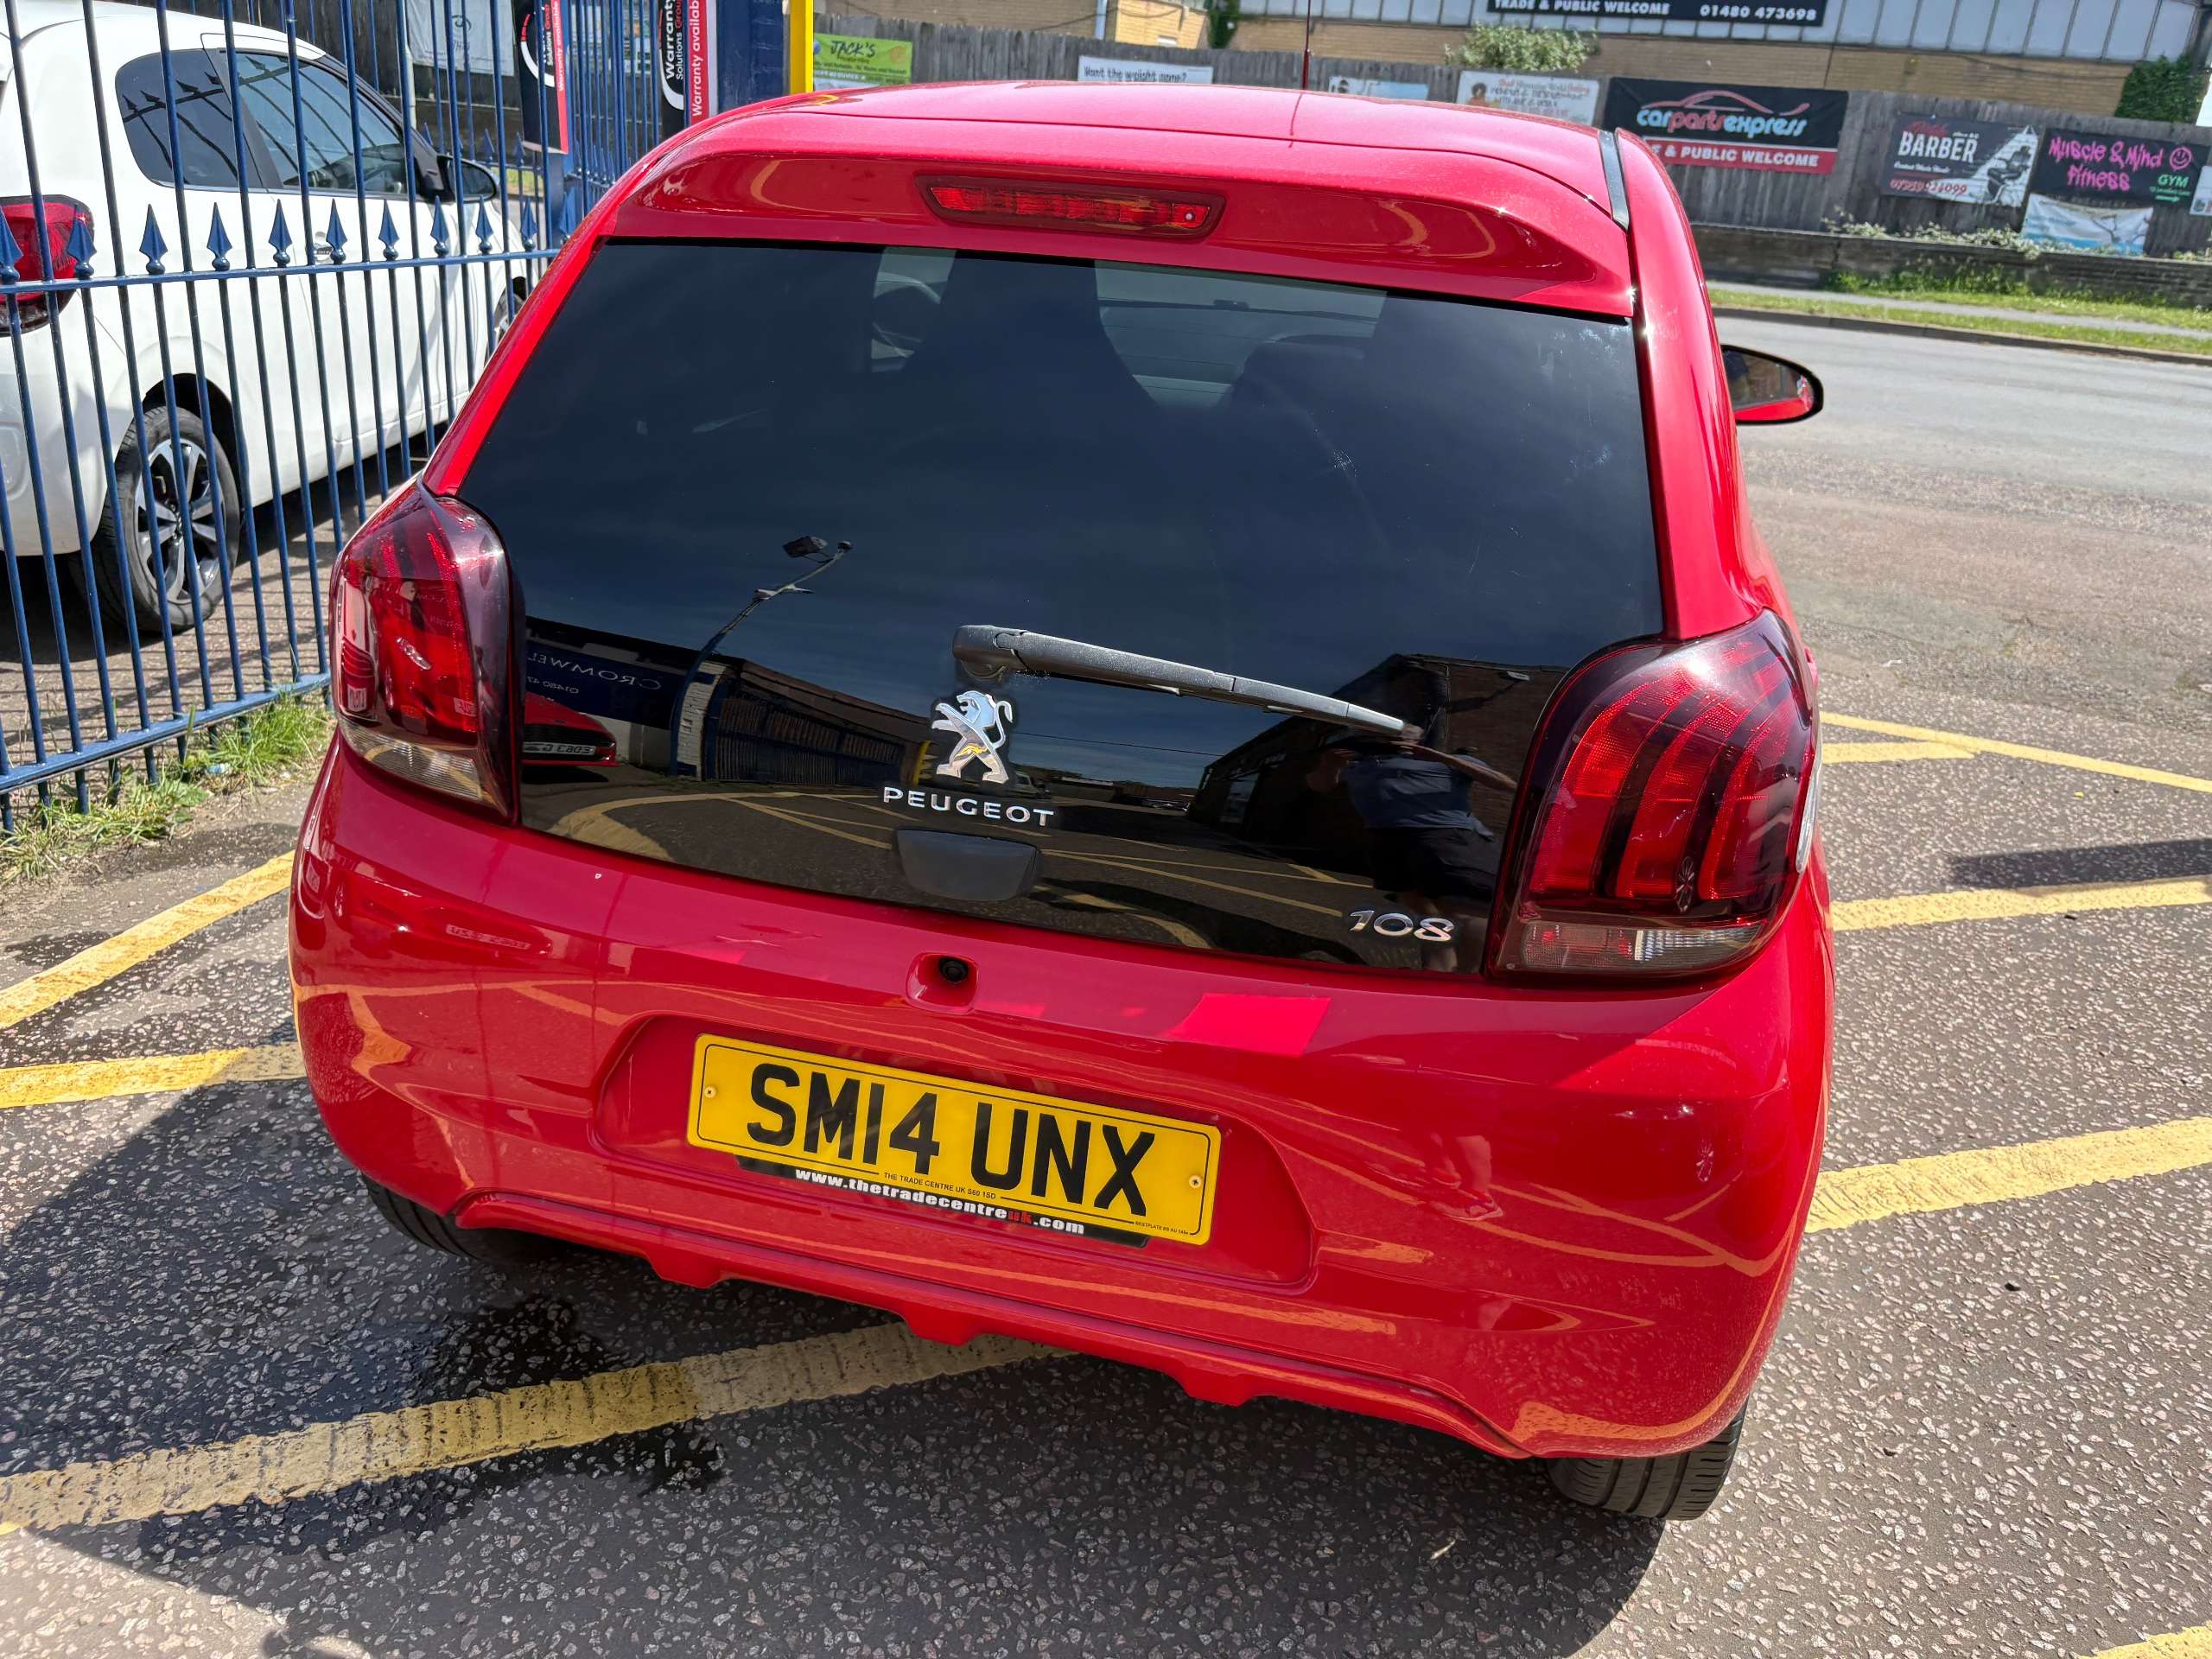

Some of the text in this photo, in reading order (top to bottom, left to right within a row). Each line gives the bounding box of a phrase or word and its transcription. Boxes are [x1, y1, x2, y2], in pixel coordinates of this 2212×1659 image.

[1554, 0, 1601, 12] PUBLIC
[1605, 1, 1670, 15] WELCOME
[1700, 4, 1751, 18] 01480
[1755, 7, 1817, 21] 473698
[691, 55, 703, 116] Warranty
[1665, 145, 1676, 157] &
[1681, 145, 1737, 162] PUBLIC
[1742, 150, 1819, 167] WELCOME
[1897, 130, 1978, 163] BARBER
[2158, 174, 2190, 188] GYM
[883, 786, 1054, 827] PEUGEOT
[1350, 910, 1455, 942] 108
[747, 1063, 1155, 1217] SM14 UNX
[884, 1172, 898, 1180] THE
[899, 1175, 923, 1185] TRADE
[925, 1179, 954, 1192] CENTRE
[795, 1168, 1085, 1235] www.thetradecentreuk.com
